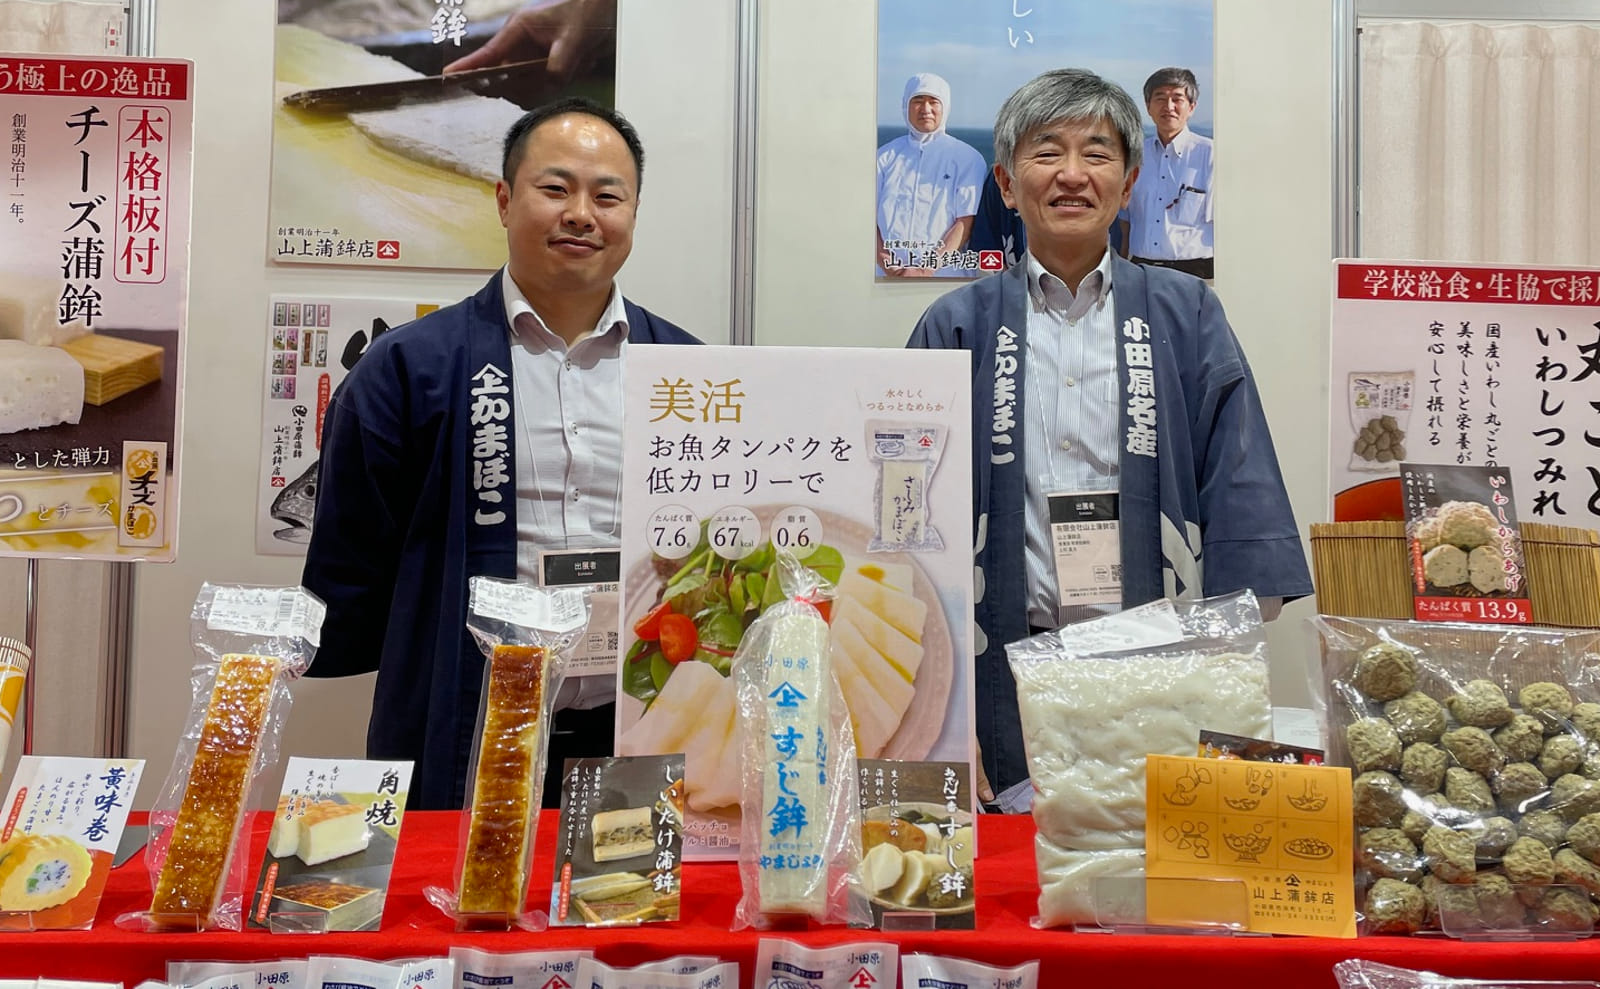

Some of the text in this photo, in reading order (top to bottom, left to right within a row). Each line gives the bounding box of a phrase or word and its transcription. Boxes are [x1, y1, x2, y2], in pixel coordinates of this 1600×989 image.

[431, 0, 469, 47] 鉾
[121, 109, 164, 276] 本格板付
[59, 105, 109, 327] チーズ蒲鉾
[278, 238, 375, 258] 山上蒲鉾店
[886, 251, 979, 269] 山上蒲鉾店
[1364, 269, 1600, 303] 学校給食・生協で採
[886, 389, 923, 399] 水々しく
[1123, 316, 1158, 458] 小田原名産
[1426, 321, 1446, 446] 安心して摂れる
[1456, 321, 1475, 465] 美味しさと栄養が
[649, 377, 746, 424] 美活
[867, 402, 944, 412] つるっとなめらか
[1532, 327, 1568, 517] いわしつみれ
[14, 447, 110, 470] とした弾力
[649, 433, 852, 462] お魚タンパクを
[646, 466, 825, 496] 低カロリーで
[38, 499, 114, 522] とチーズ
[655, 515, 693, 523] たんぱく質
[716, 515, 754, 523] エネルギー
[1489, 475, 1521, 593] いわしからあげ
[1418, 601, 1473, 613] たんぱく質
[364, 768, 399, 826] 角焼
[653, 764, 677, 894] しいたけ蒲鉾
[1253, 887, 1335, 905] 山上蒲鉾店
